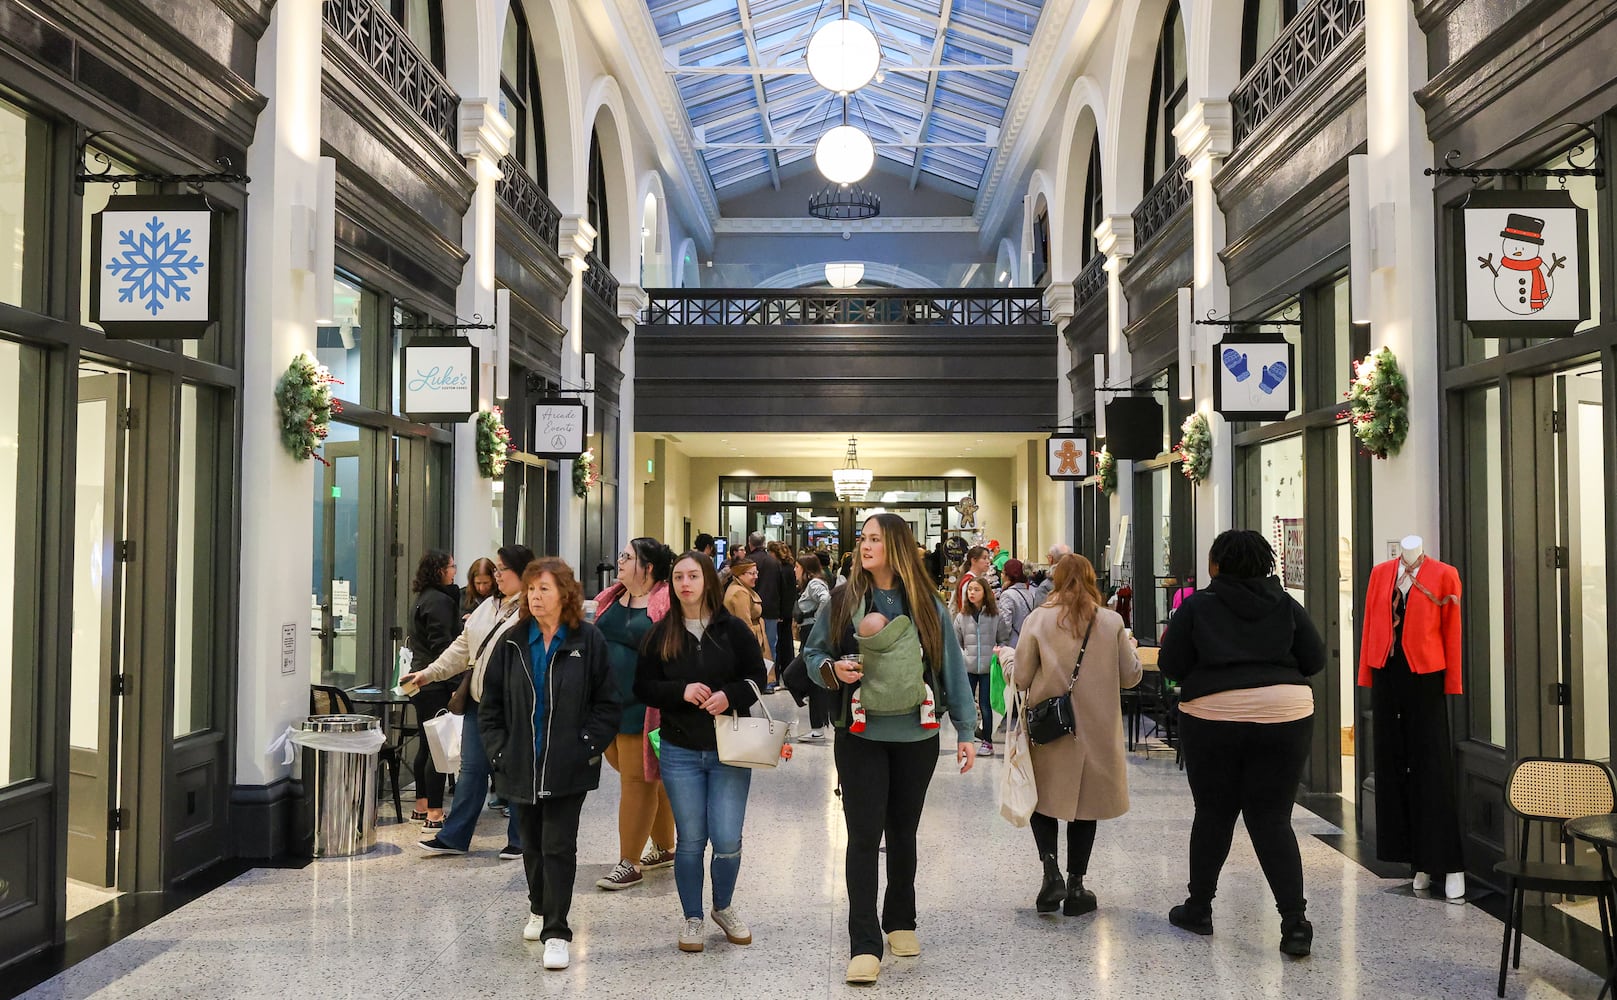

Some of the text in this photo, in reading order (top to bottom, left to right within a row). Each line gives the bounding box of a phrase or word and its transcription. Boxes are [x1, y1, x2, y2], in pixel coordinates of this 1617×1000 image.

[408, 366, 467, 391] Luke's
[542, 407, 576, 420] Arcade
[544, 420, 574, 434] Events
